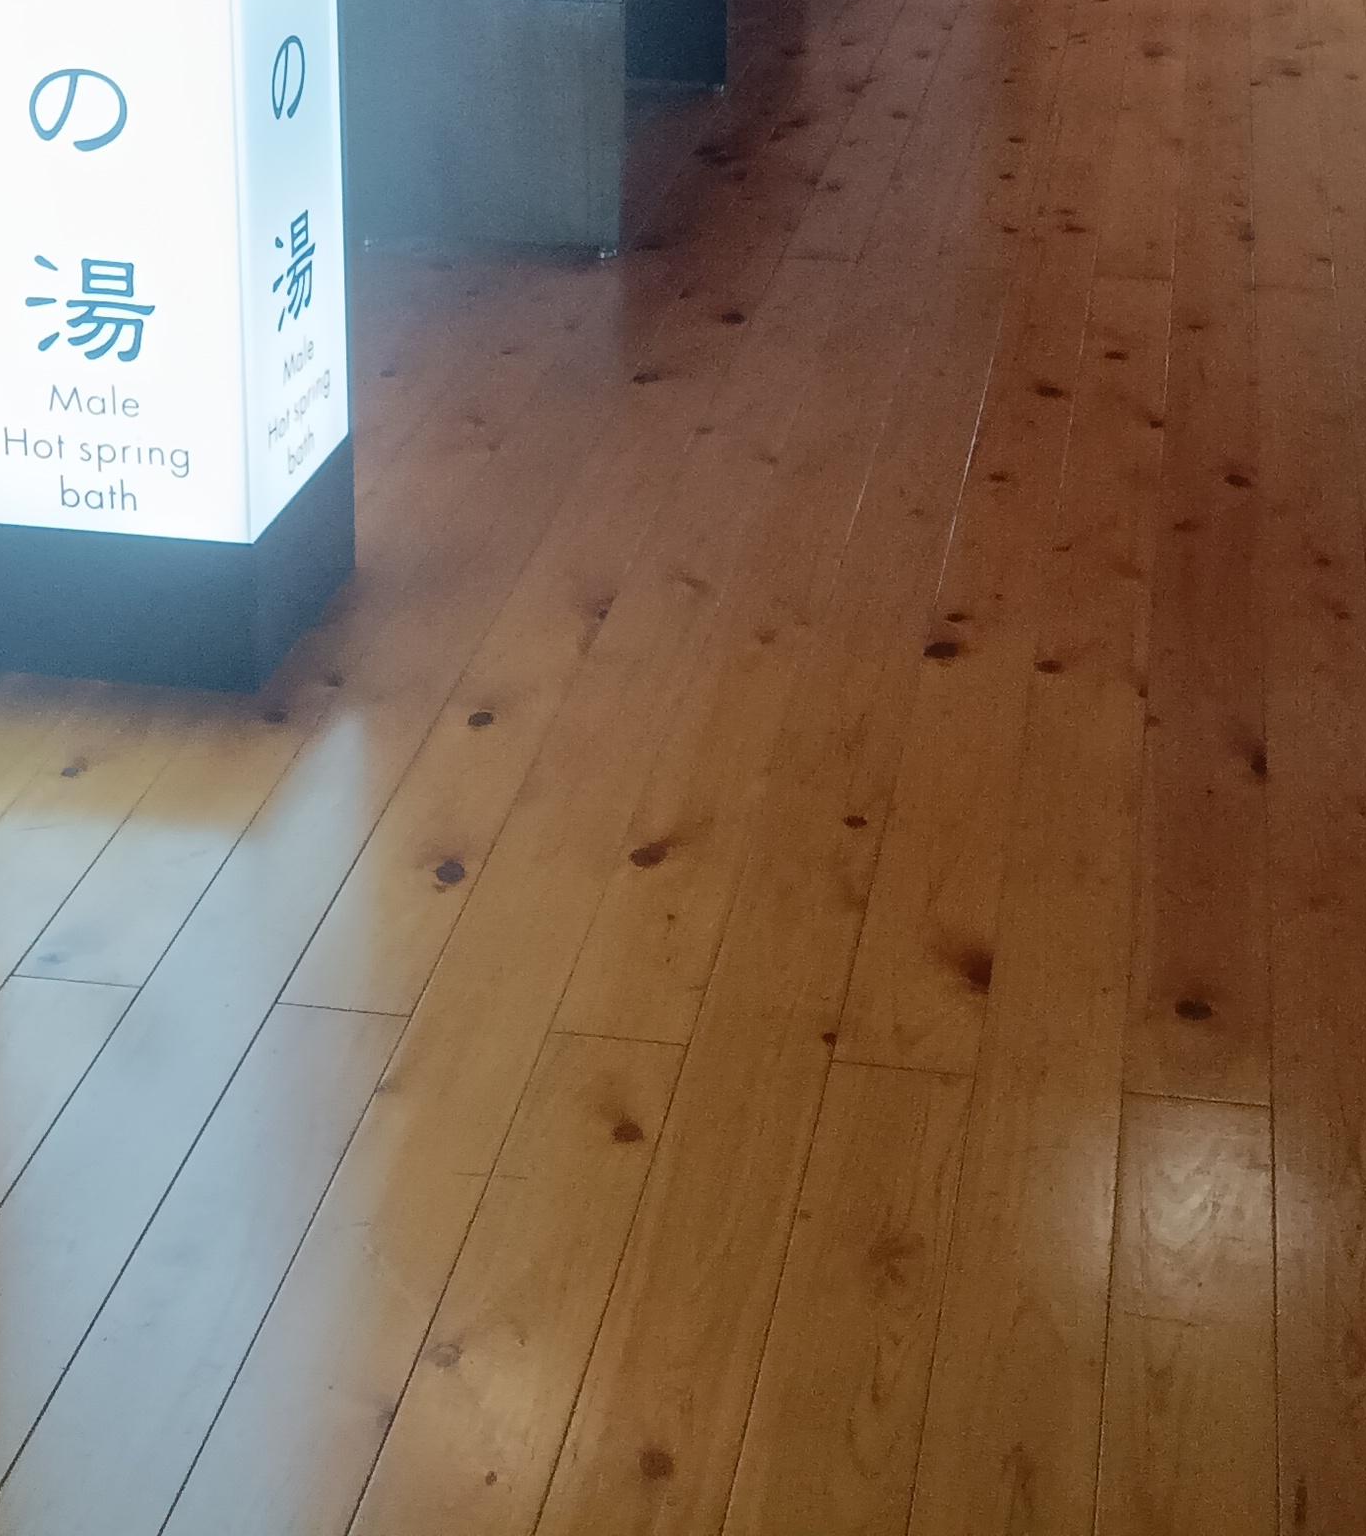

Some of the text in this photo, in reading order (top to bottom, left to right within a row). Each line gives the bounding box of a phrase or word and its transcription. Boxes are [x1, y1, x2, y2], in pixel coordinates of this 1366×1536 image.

[283, 335, 315, 387] Male
[49, 385, 140, 418] Male
[266, 367, 331, 453] Hot spring
[3, 426, 191, 478] Hot spring
[286, 424, 316, 476] bath
[60, 474, 138, 512] bath
